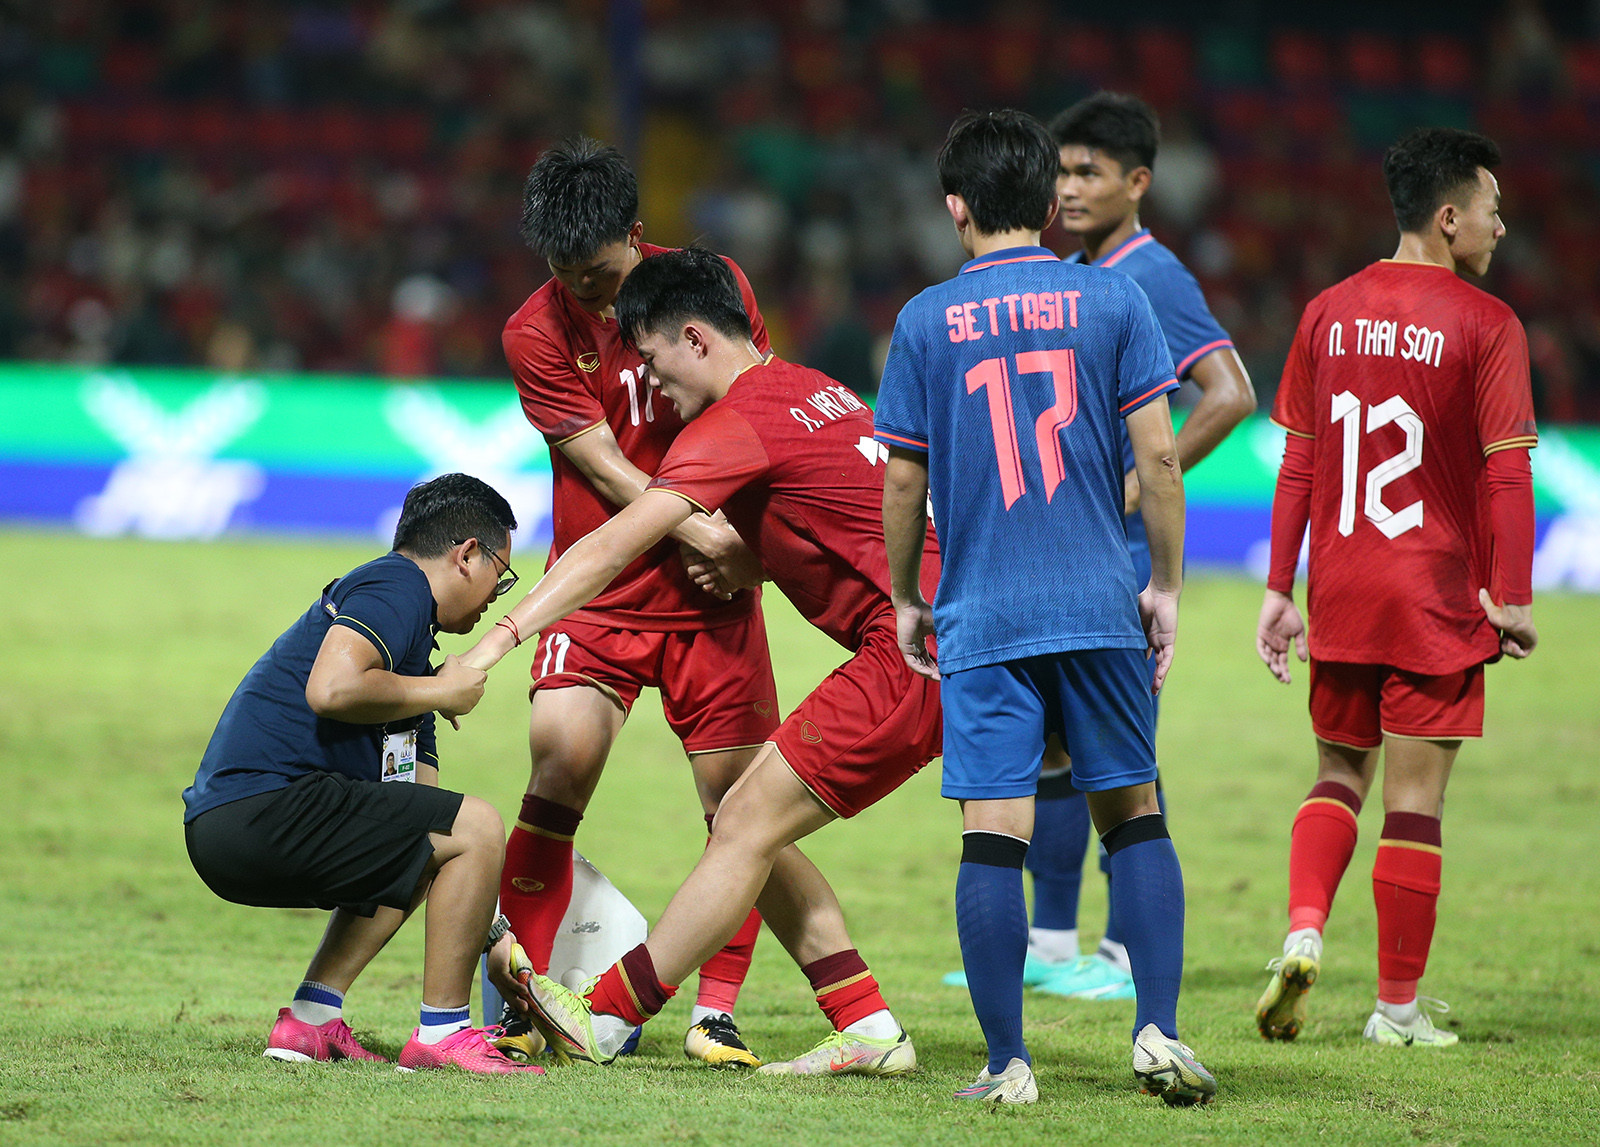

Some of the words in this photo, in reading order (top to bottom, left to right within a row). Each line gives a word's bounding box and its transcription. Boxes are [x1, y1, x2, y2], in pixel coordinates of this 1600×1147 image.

[945, 290, 1082, 343] SETTASIT
[1355, 318, 1398, 357] THAI
[1400, 323, 1445, 368] SON
[965, 348, 1078, 512] 17
[1330, 389, 1425, 540] 12
